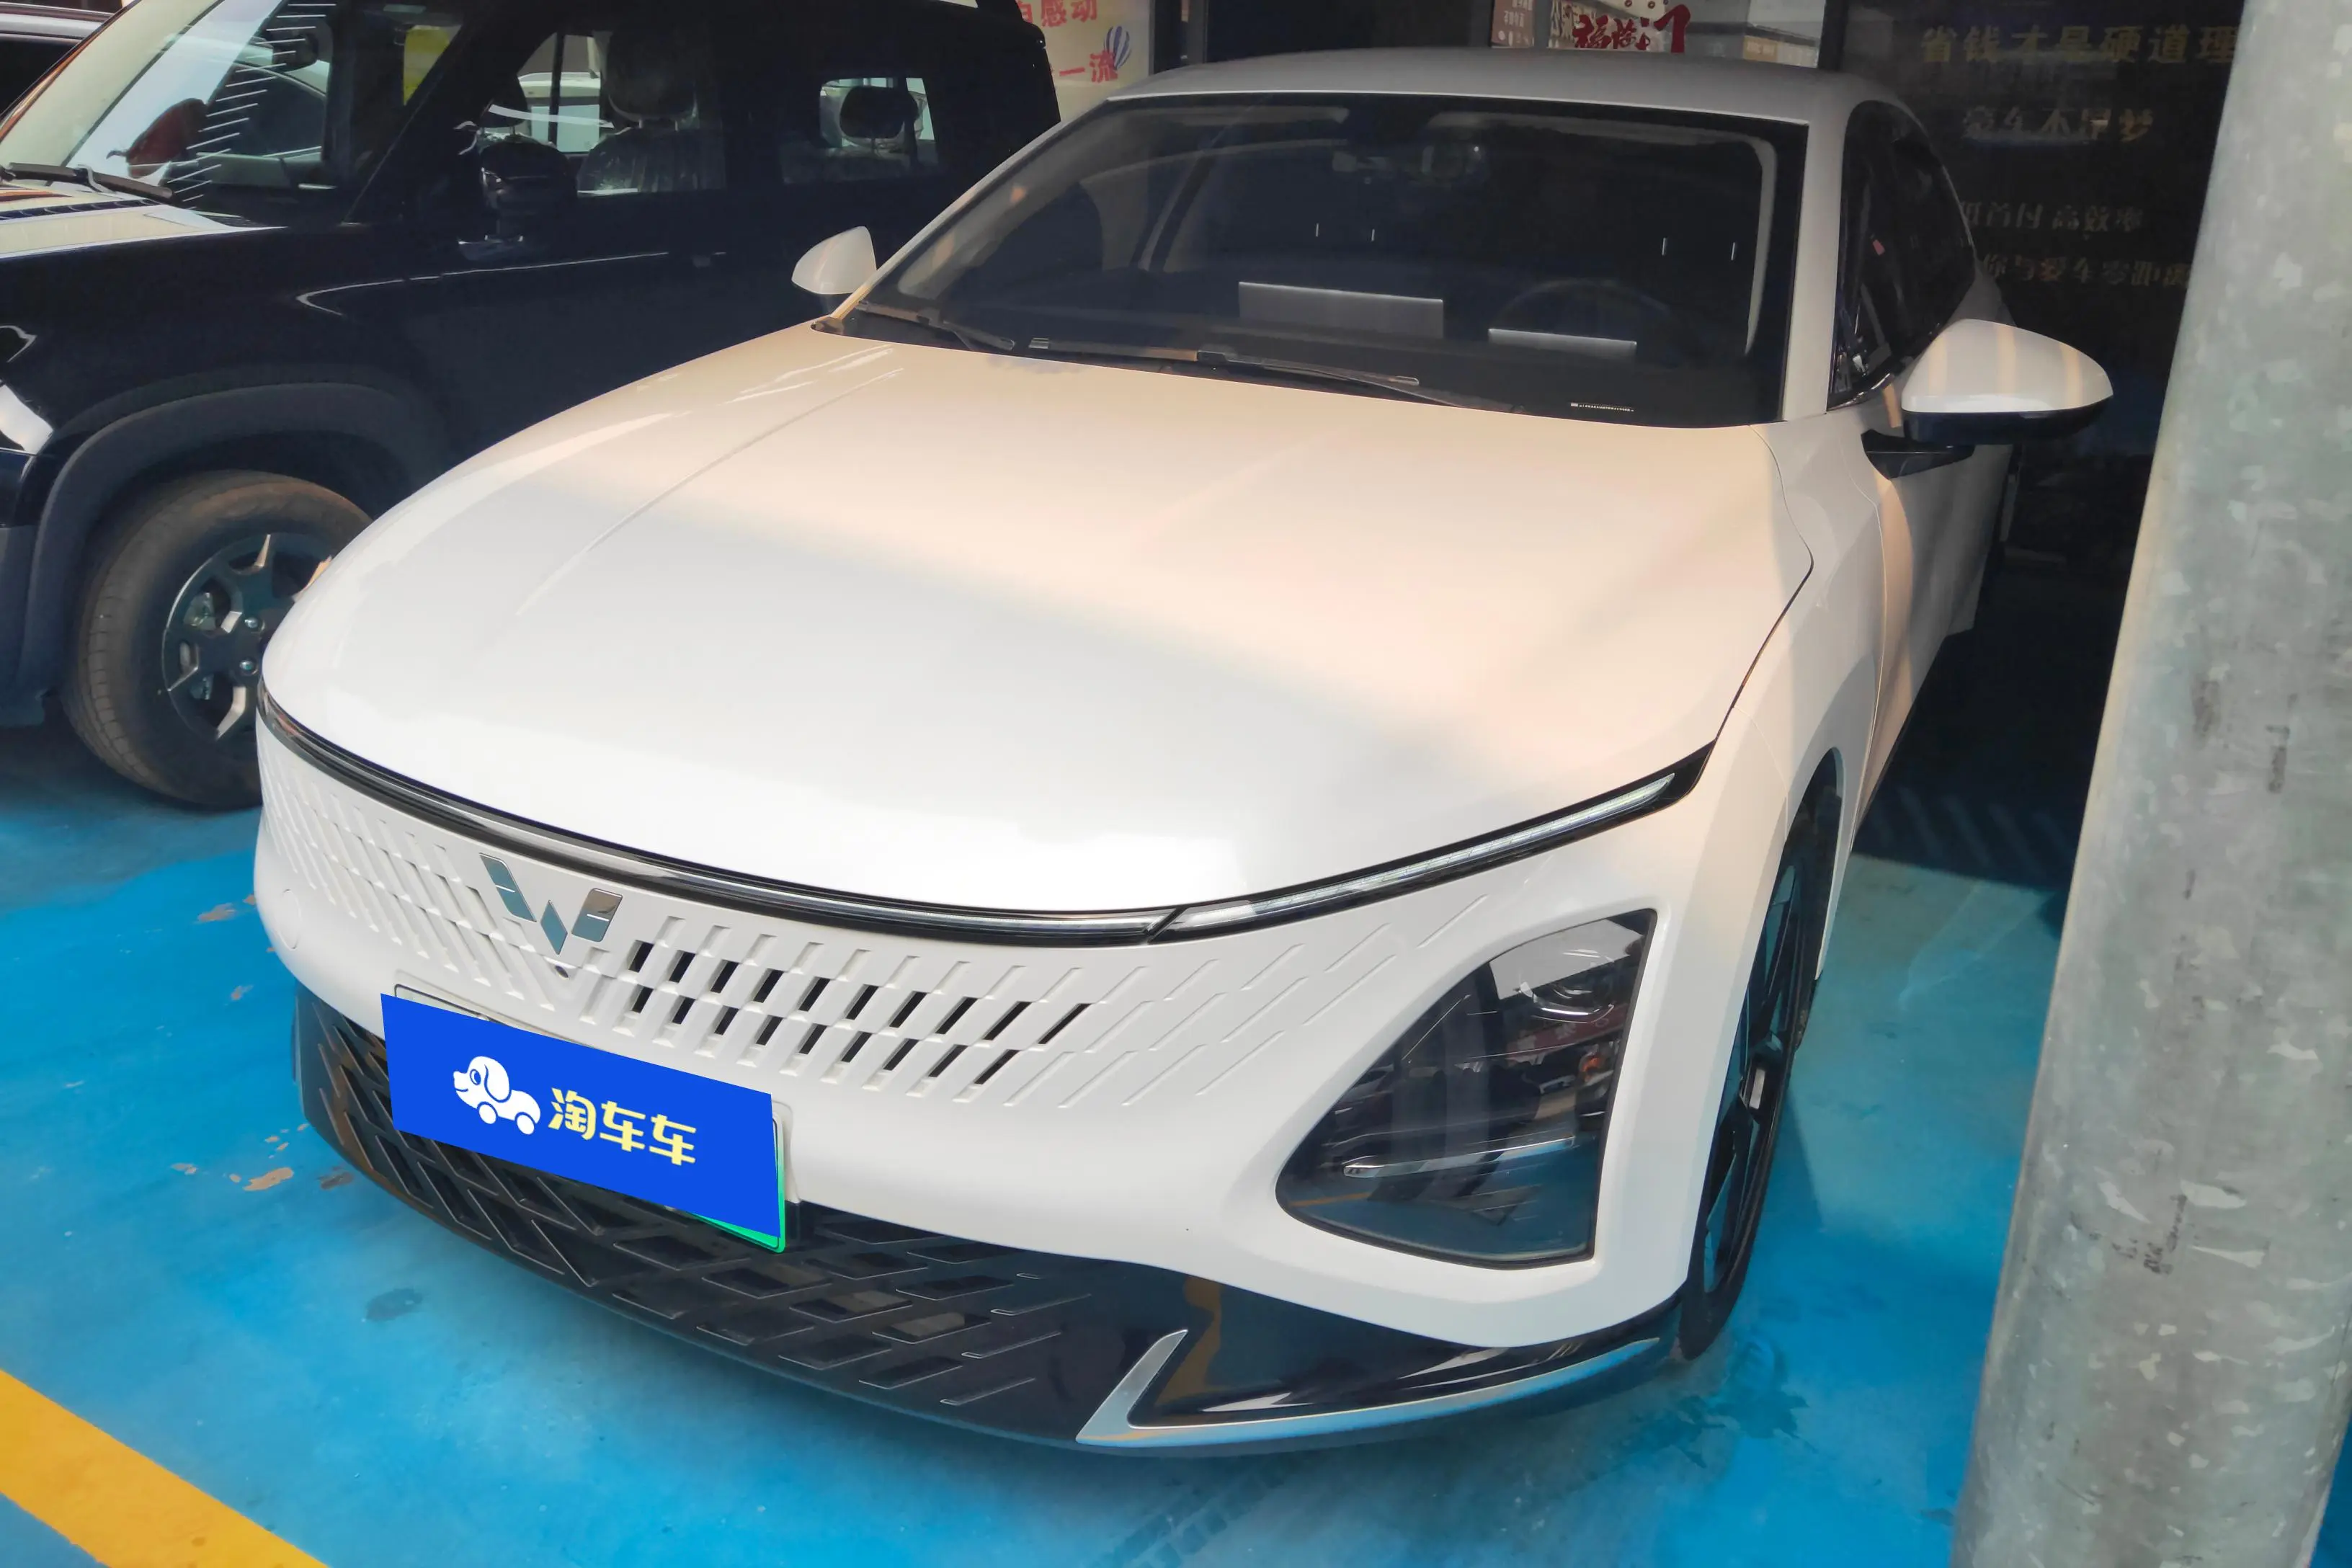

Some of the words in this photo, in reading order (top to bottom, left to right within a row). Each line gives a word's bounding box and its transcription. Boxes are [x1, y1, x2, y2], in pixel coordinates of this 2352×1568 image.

[1921, 24, 2236, 64] 省钱才是硬道理
